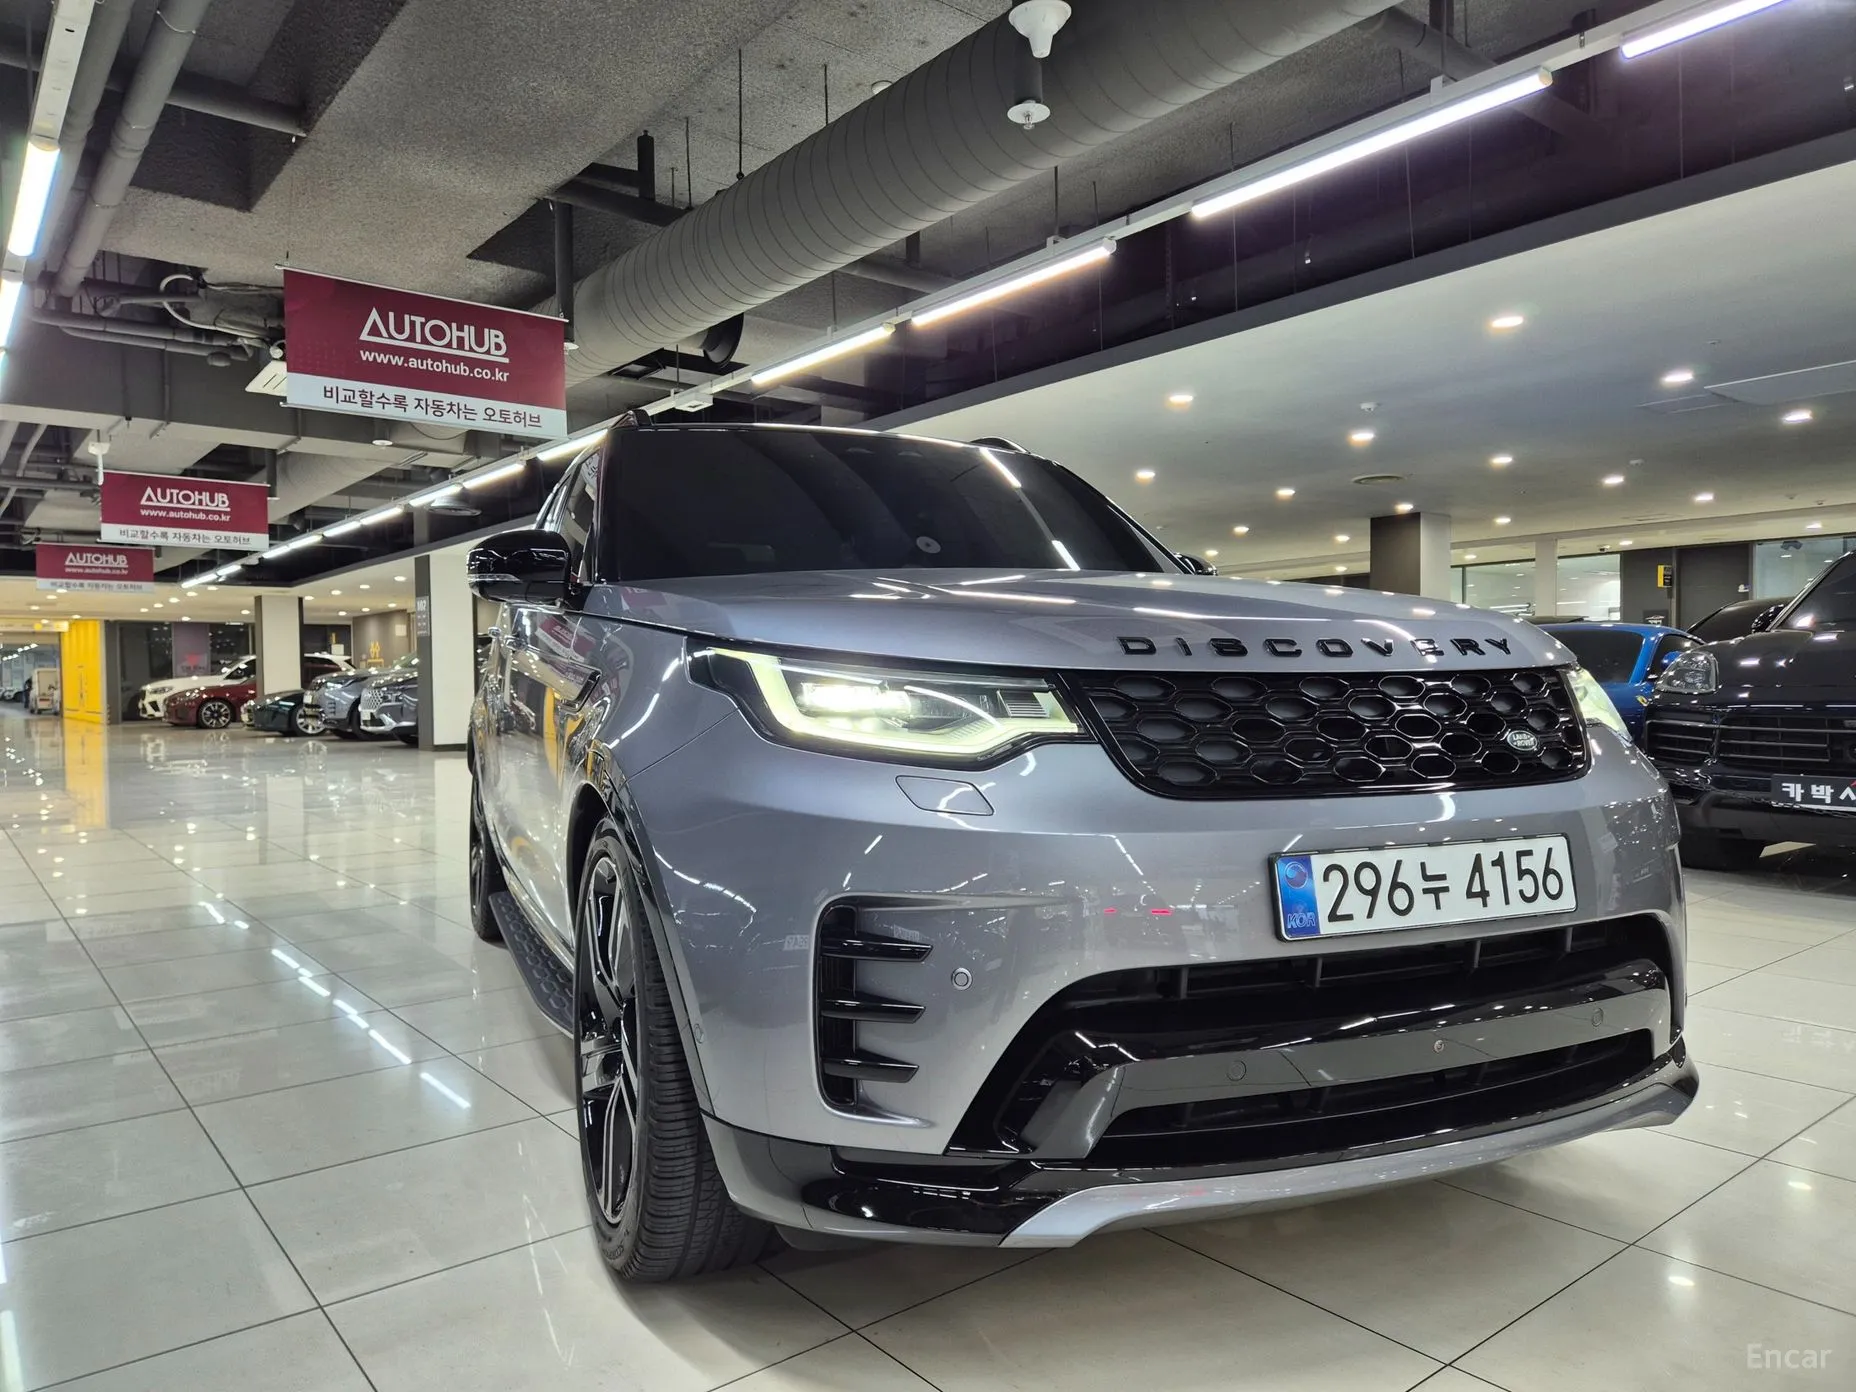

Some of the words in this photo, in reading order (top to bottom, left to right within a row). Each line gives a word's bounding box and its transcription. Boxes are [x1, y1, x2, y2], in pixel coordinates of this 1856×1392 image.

[359, 307, 509, 363] AUTOHUB
[360, 350, 509, 382] www.autohub.co.kr
[323, 385, 409, 413] 비교할수록
[414, 397, 477, 421] 자동차는
[483, 407, 542, 428] 오토허브
[140, 486, 231, 511] AUTOHUB
[140, 508, 231, 522] www.autohub.co.kr
[64, 552, 128, 568] AUTOHUB
[1116, 636, 1512, 660] DISCOVERY
[1322, 859, 1451, 923] 296누
[1465, 847, 1564, 908] 4156
[1287, 911, 1316, 928] KOR
